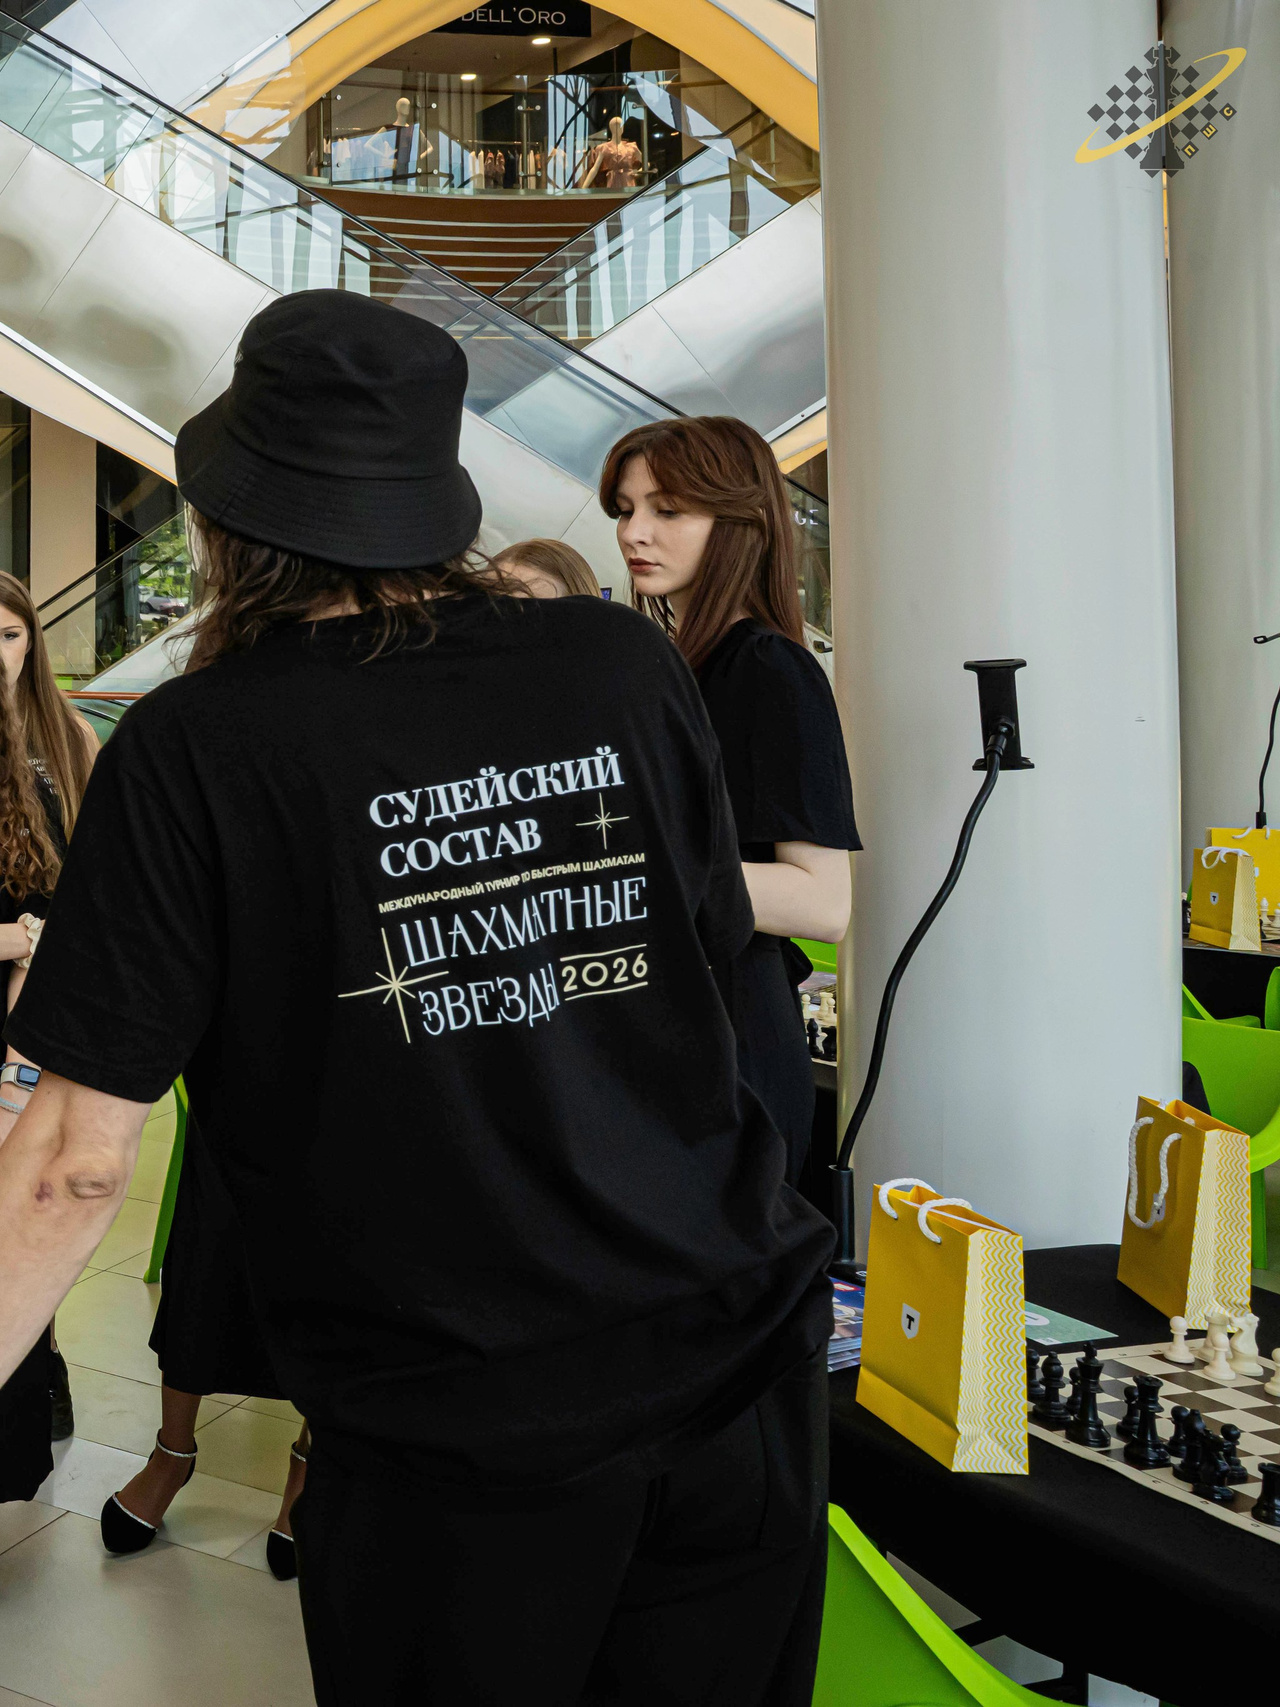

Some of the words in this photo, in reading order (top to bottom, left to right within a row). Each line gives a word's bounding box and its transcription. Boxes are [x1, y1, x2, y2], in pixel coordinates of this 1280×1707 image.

[369, 745, 625, 828] СУДЕЙСКИЙ
[378, 882, 485, 913] МЕЖДУНАРОДНЫЙ
[485, 875, 520, 892] ТУРНИР
[531, 862, 581, 879] БЫСТРЫМ
[582, 853, 645, 871] ШАХМАТАМ
[380, 818, 542, 877] СОСТАВ
[400, 876, 648, 967] ШАХМАТНЫЕ
[418, 963, 560, 1036] ЗВЕЗДЫ
[561, 953, 648, 993] 2026
